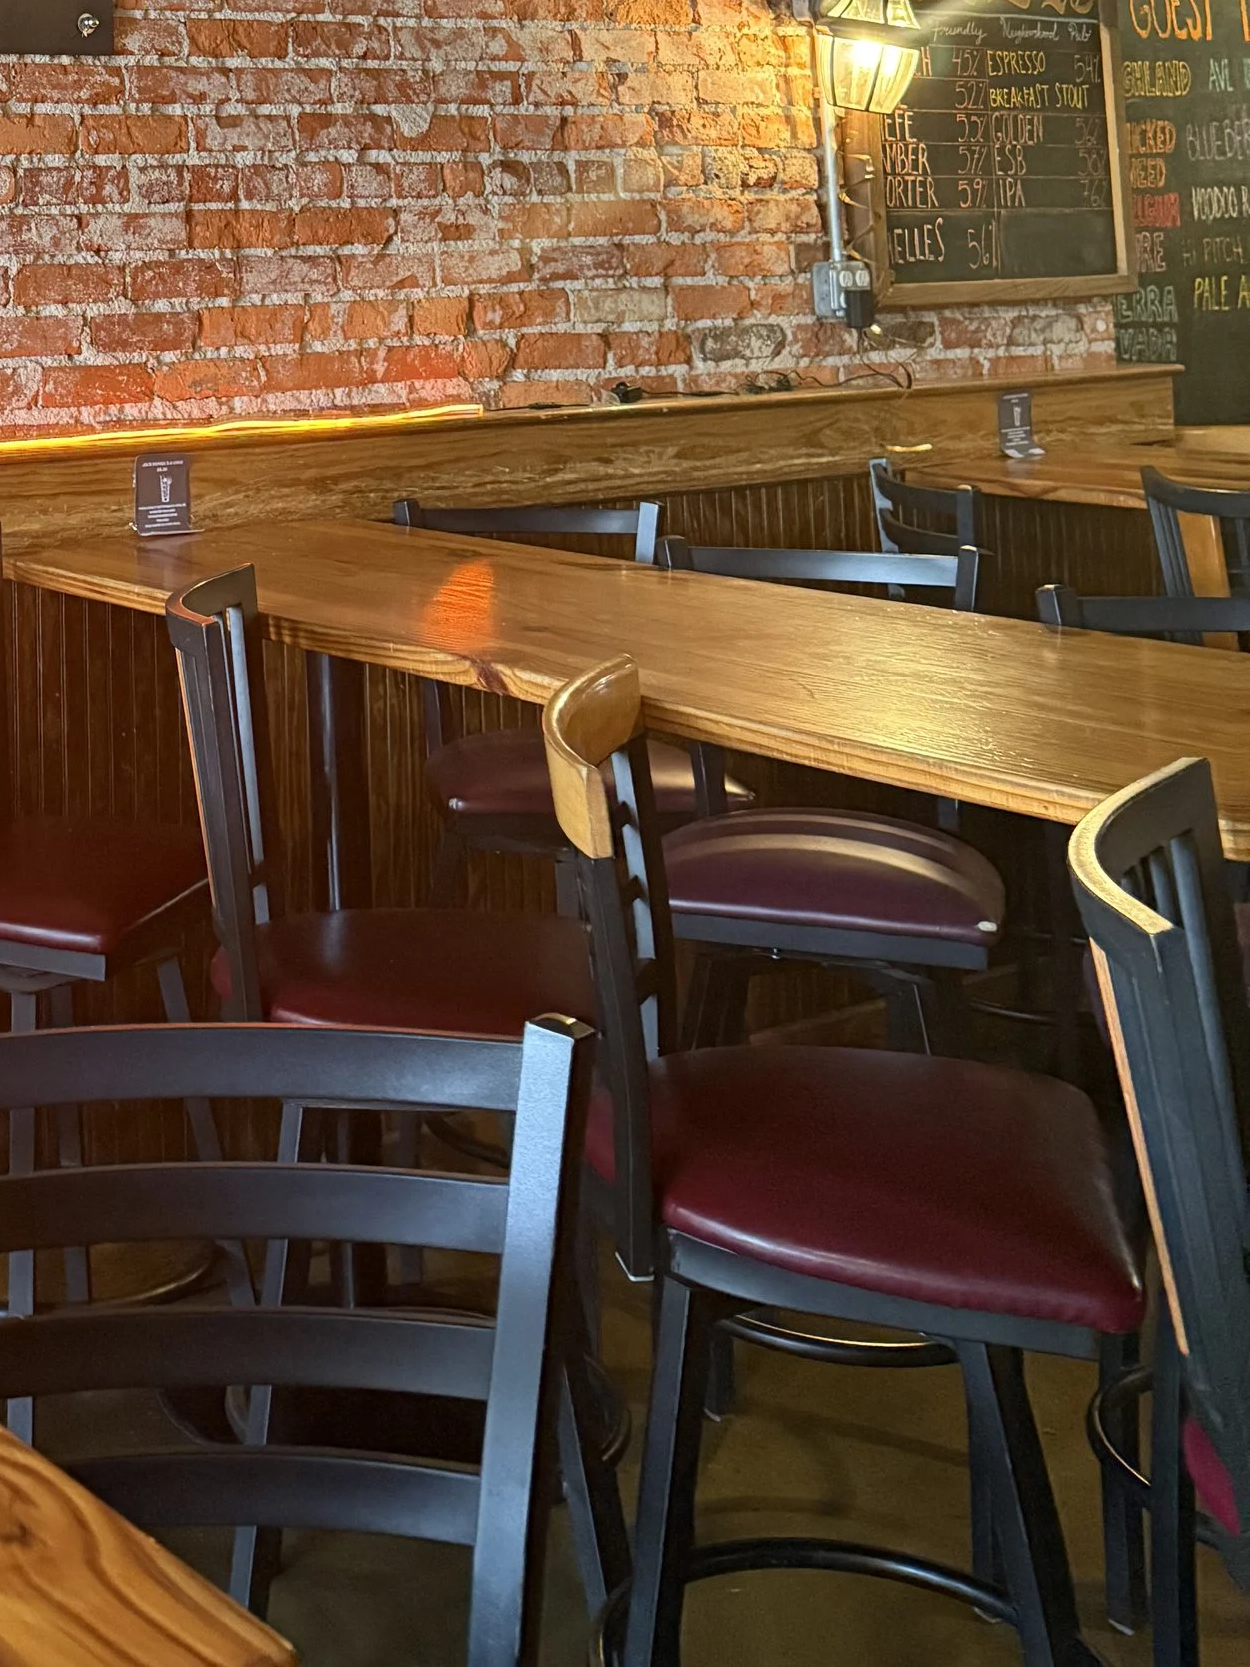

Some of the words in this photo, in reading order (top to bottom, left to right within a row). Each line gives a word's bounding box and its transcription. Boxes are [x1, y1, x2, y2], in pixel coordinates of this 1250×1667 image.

[986, 49, 1046, 76] ESPRESSO
[1122, 59, 1192, 97] GHLAND
[1208, 57, 1234, 92] AVL
[1054, 82, 1090, 109] STOUT
[991, 112, 1045, 146] GOLDEN
[1126, 118, 1177, 155] ICKED
[994, 144, 1027, 176] ESB
[886, 176, 940, 210] ORTER
[999, 178, 1027, 207] IPA
[1115, 284, 1180, 323] ERRA
[1193, 275, 1230, 312] PALE
[1117, 327, 1178, 363] VADA
